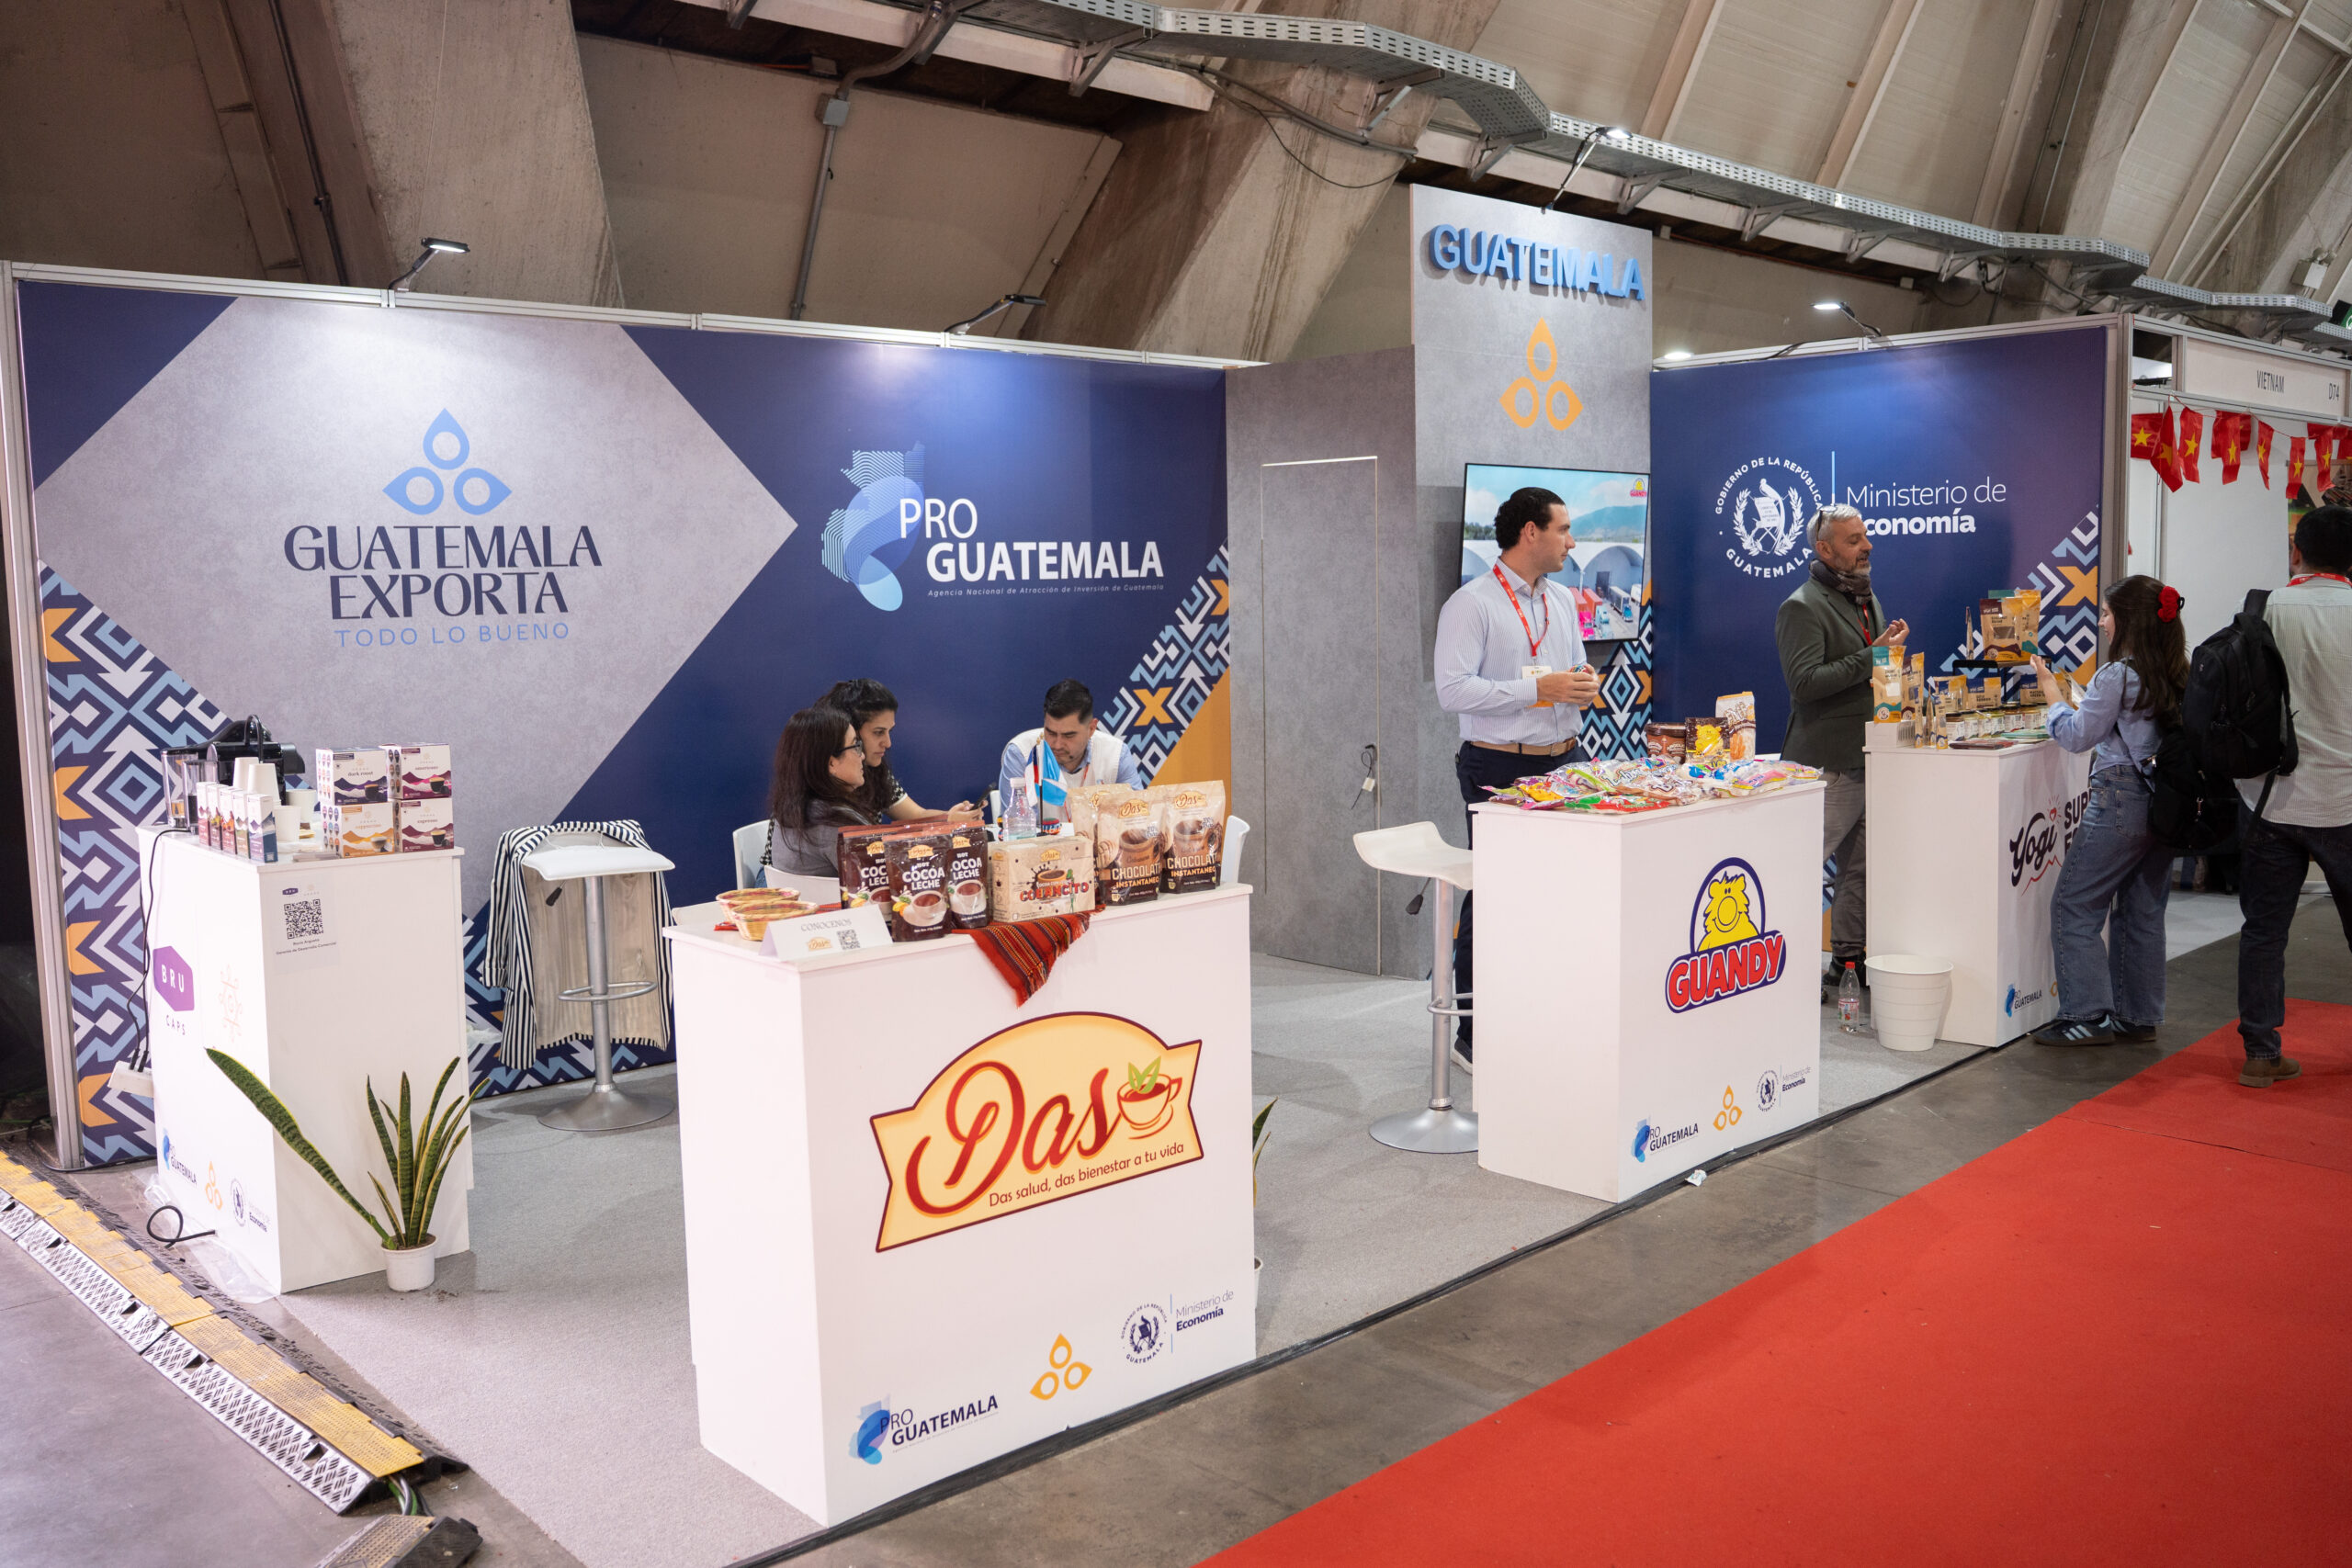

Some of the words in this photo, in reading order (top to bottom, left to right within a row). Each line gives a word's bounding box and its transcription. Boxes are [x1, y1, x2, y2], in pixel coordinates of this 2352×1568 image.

[1430, 223, 1645, 301] GUATEMALA
[2256, 369, 2285, 393] VIETNAM
[2328, 383, 2340, 400] D74
[1714, 464, 1748, 514] GOBIERNO
[1751, 457, 1765, 468] DE
[1768, 457, 1781, 466] LA
[1783, 459, 1823, 510] REPÚBLICA
[1847, 479, 1967, 507] Ministerio
[1973, 476, 2007, 503] de
[899, 498, 978, 539] PRO
[1862, 508, 1976, 536] conomía
[284, 525, 603, 571] GUATEMALA
[926, 541, 1164, 582] GUATEMALA
[1726, 547, 1813, 578] GUATEMALA
[329, 571, 569, 620] EXPORTA
[927, 589, 963, 598] Agencia
[967, 588, 1003, 596] Nacional
[1020, 586, 1058, 594] Atracción
[1124, 583, 1164, 592] Guatemala
[334, 628, 417, 647] TODO
[432, 626, 465, 644] LO
[479, 623, 569, 642] BUENO
[1121, 802, 1141, 817] Das
[2064, 788, 2092, 830] SUP
[1167, 853, 1216, 870] CHOCOLAT
[2009, 812, 2058, 887] Yogi
[861, 866, 887, 878] COC
[869, 876, 888, 886] LEC
[902, 867, 944, 883] COCOA
[954, 869, 979, 880] LECHE
[1116, 876, 1159, 888] INSTANTANEO
[1171, 865, 1216, 877] INSTANTANEO
[911, 879, 940, 890] LECHE
[1020, 882, 1090, 902] COBANCITO
[162, 964, 184, 993] BRU
[1668, 933, 1783, 1009] GUANDY
[2014, 989, 2042, 1009] GUATEMALA
[166, 1014, 186, 1035] CAPS
[1781, 1076, 1806, 1092] Economía
[905, 1061, 1122, 1217] Das
[1645, 1126, 1661, 1142] PRO
[1649, 1122, 1699, 1151] GUATEMALA
[171, 1156, 197, 1185] GUATEMALA
[989, 1192, 1012, 1207] Das
[1015, 1179, 1051, 1200] salud,
[1055, 1173, 1076, 1189] das
[1079, 1157, 1131, 1181] bienestar
[1134, 1156, 1142, 1166] a
[1145, 1150, 1157, 1163] tu
[1159, 1143, 1184, 1159] vida
[1176, 1294, 1221, 1319] Ministerio
[1223, 1289, 1234, 1303] de
[1176, 1305, 1224, 1332] Economía
[1125, 1342, 1163, 1364] GUATEMALA
[879, 1409, 913, 1435] PRO
[892, 1394, 999, 1446] GUATEMALA
